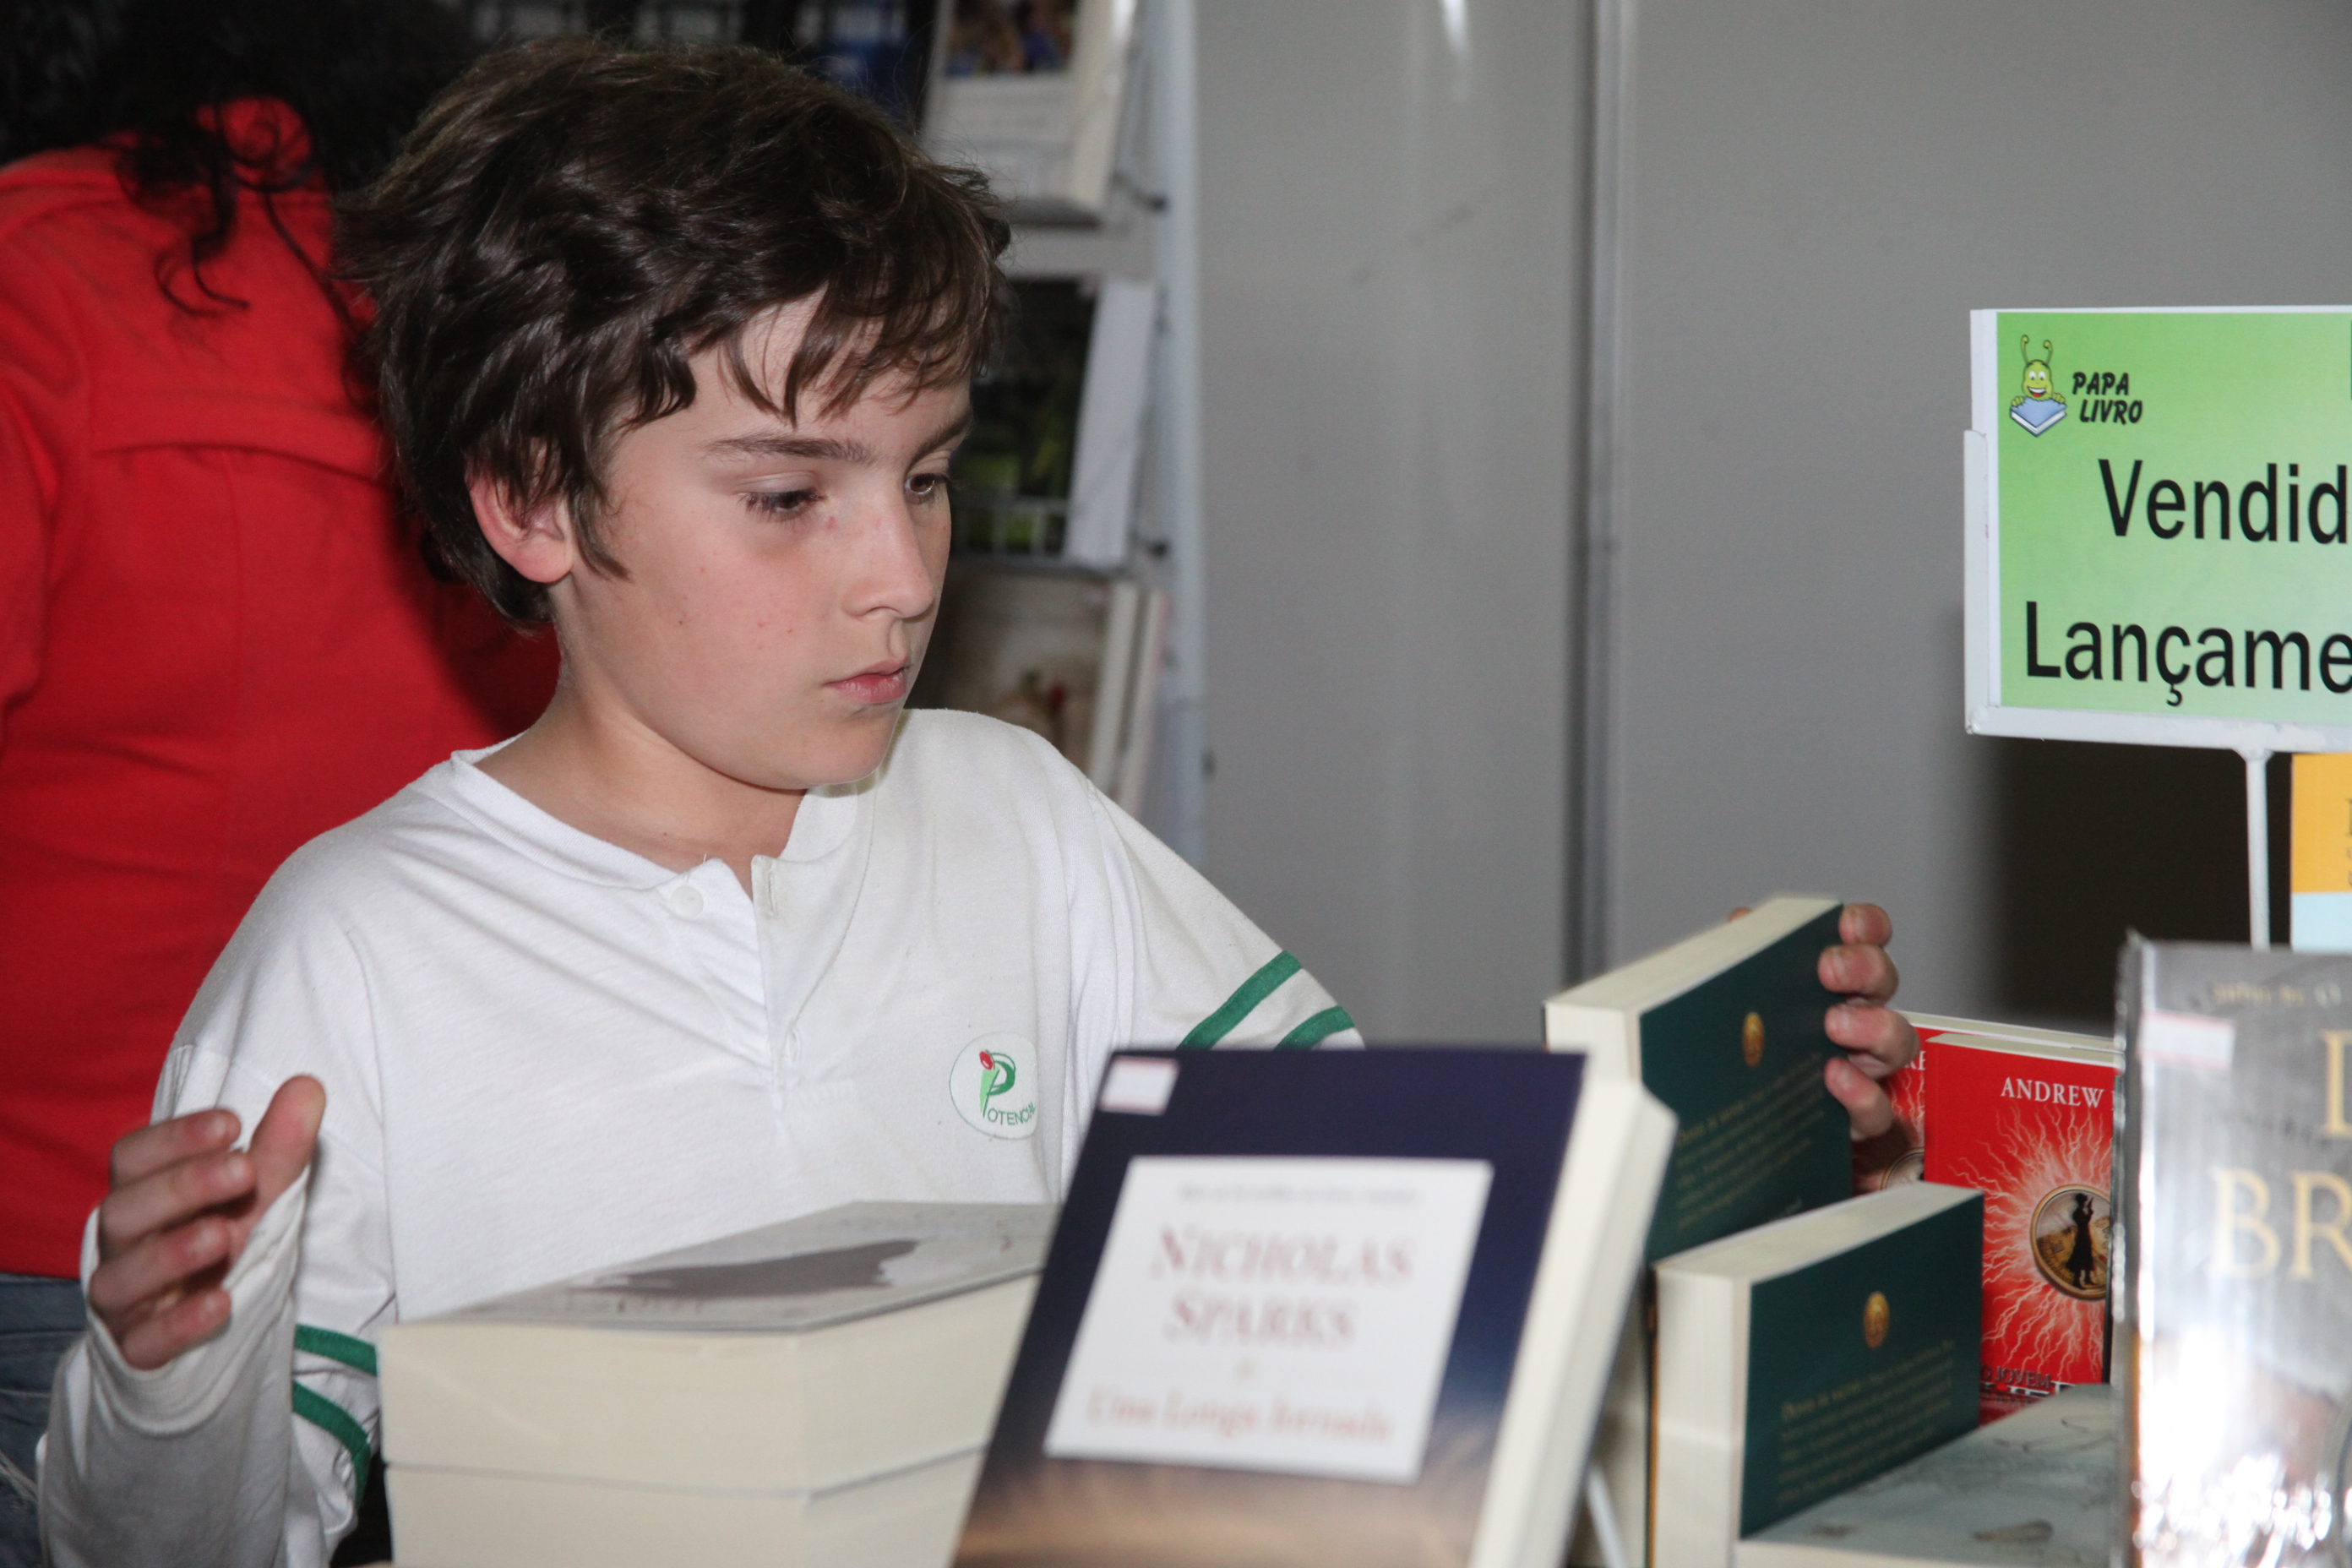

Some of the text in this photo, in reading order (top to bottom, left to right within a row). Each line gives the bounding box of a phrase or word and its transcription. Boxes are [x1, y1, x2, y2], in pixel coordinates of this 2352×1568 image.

[2072, 372, 2129, 396] PAPA
[2079, 400, 2143, 424] LIVRO
[2001, 1077, 2104, 1108] ANDREW
[1995, 1365, 2050, 1389] JOVEM
